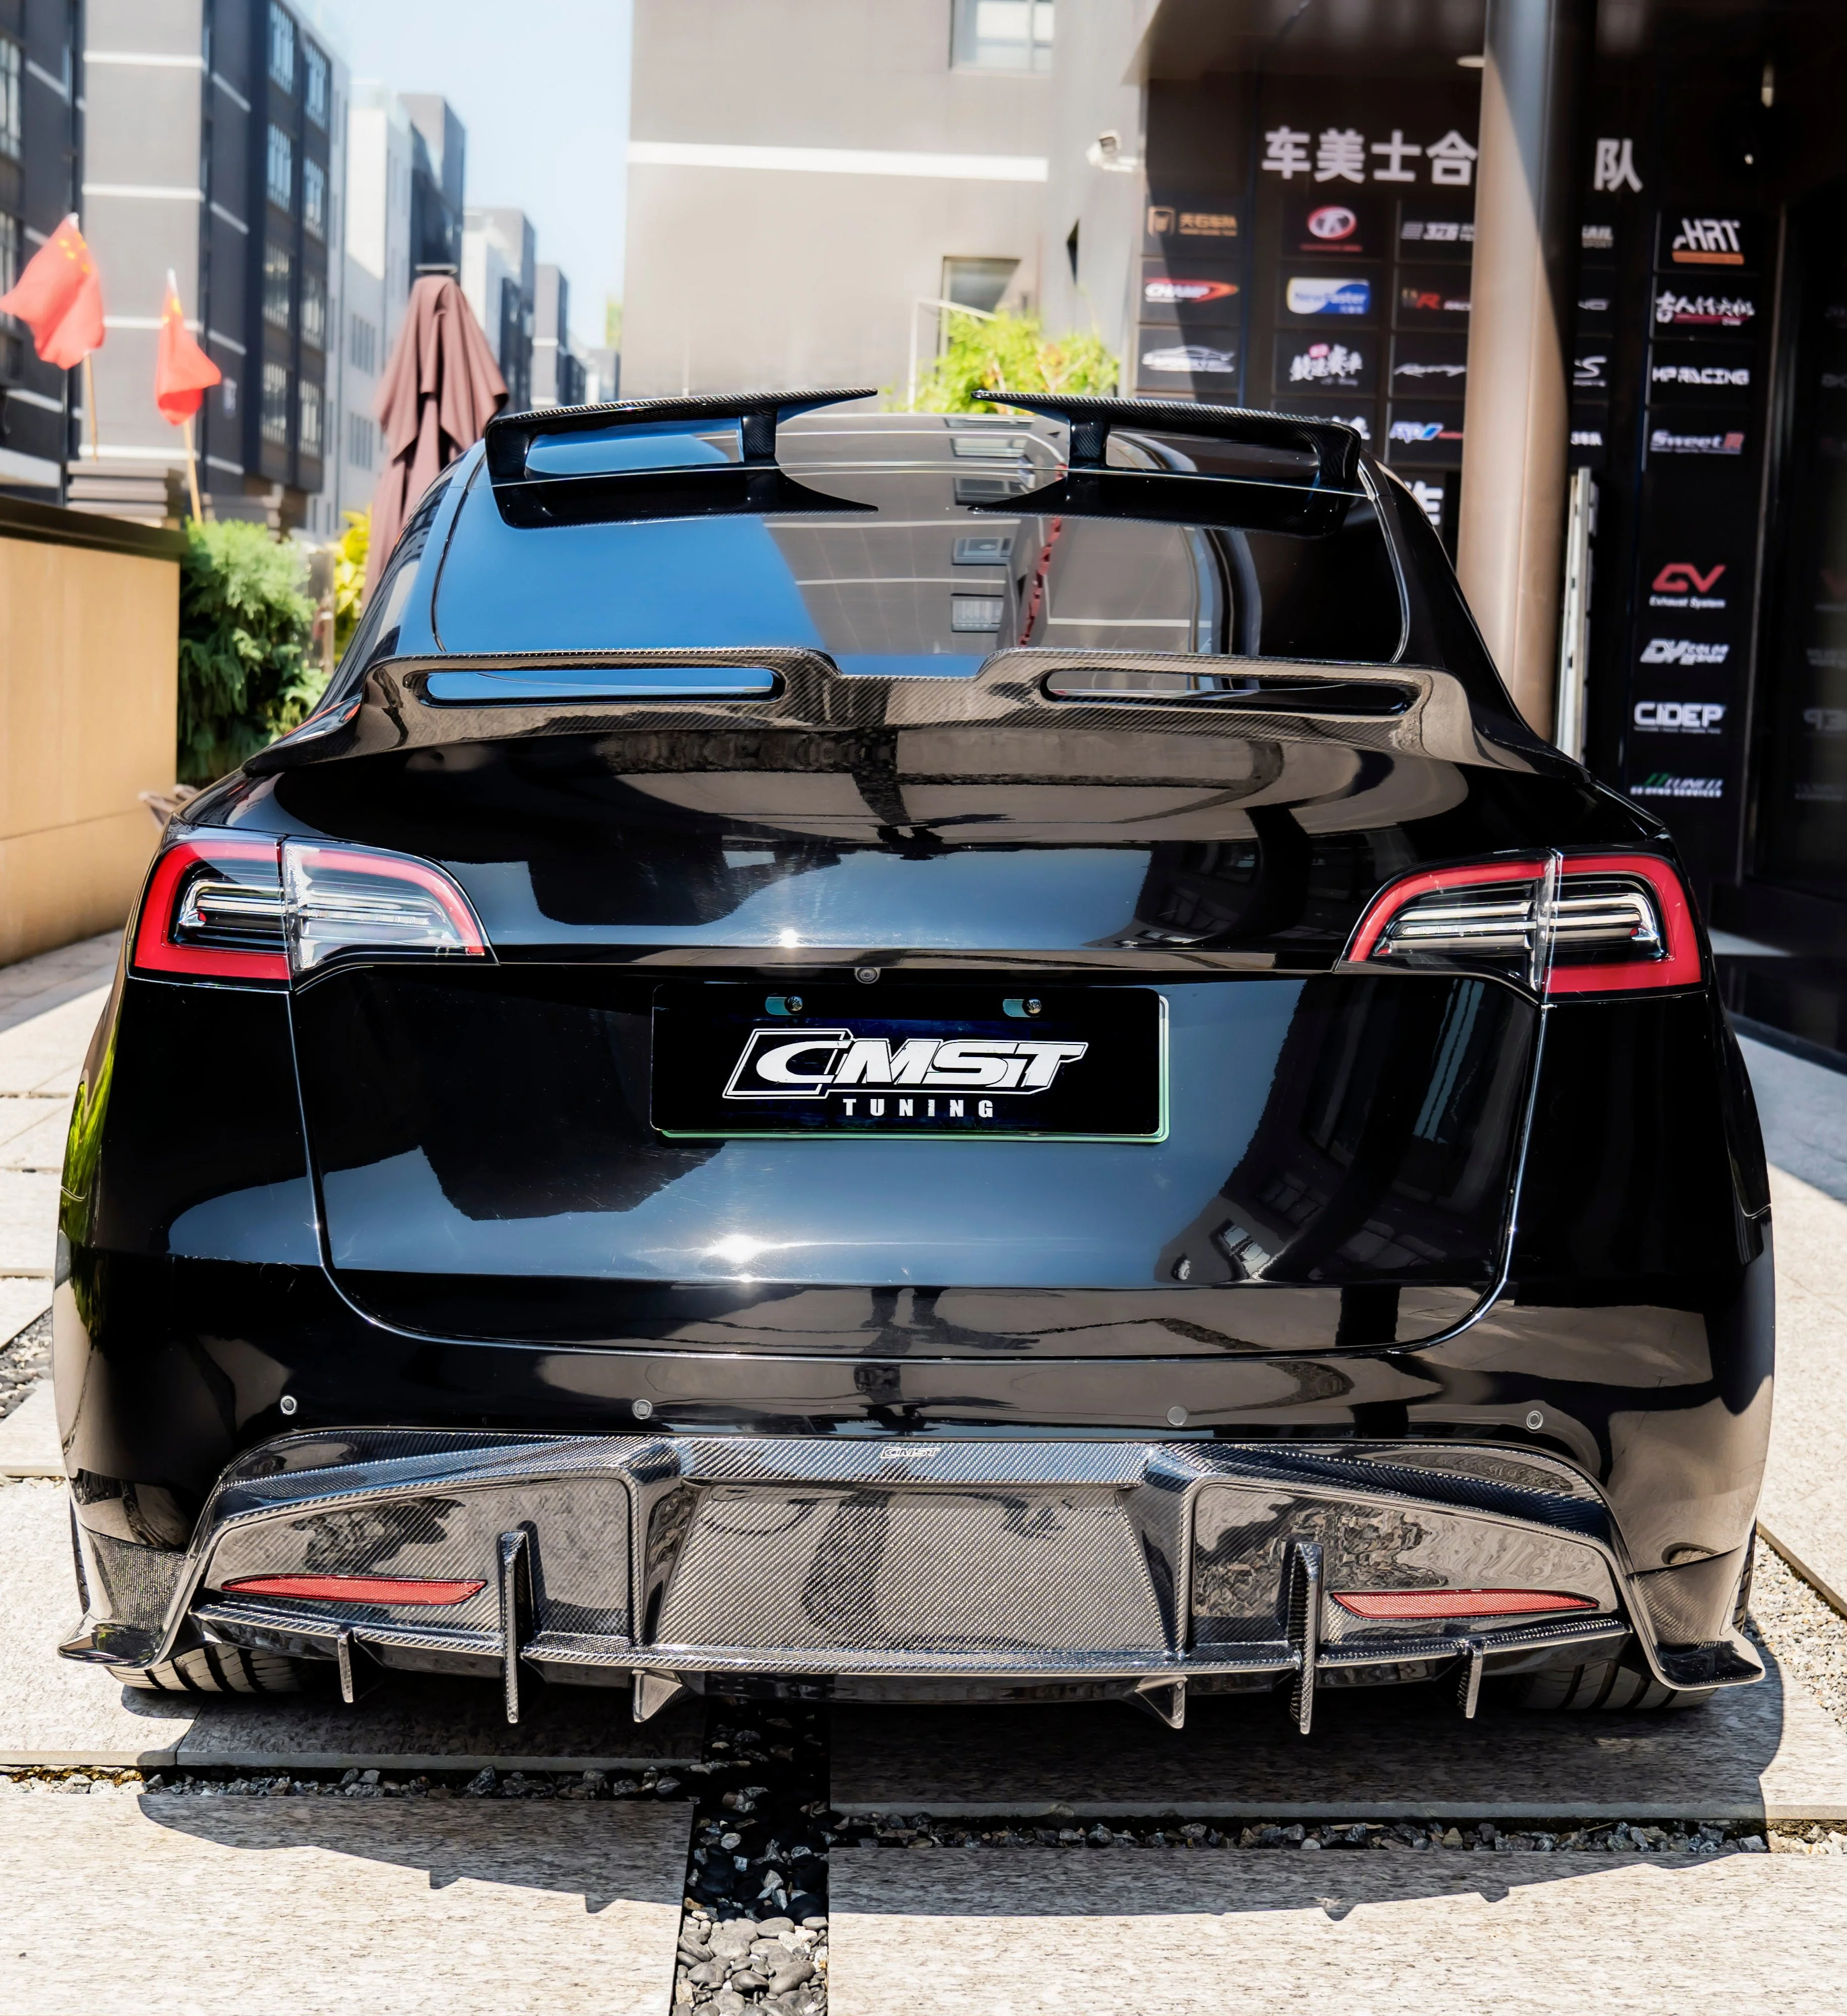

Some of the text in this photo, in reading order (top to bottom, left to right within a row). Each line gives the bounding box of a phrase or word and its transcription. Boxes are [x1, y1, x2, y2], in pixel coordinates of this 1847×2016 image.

[1634, 701, 1723, 727] CIDEP
[731, 1030, 1089, 1095] CMST
[842, 1098, 994, 1118] TUNING
[881, 1446, 941, 1459] CMST
